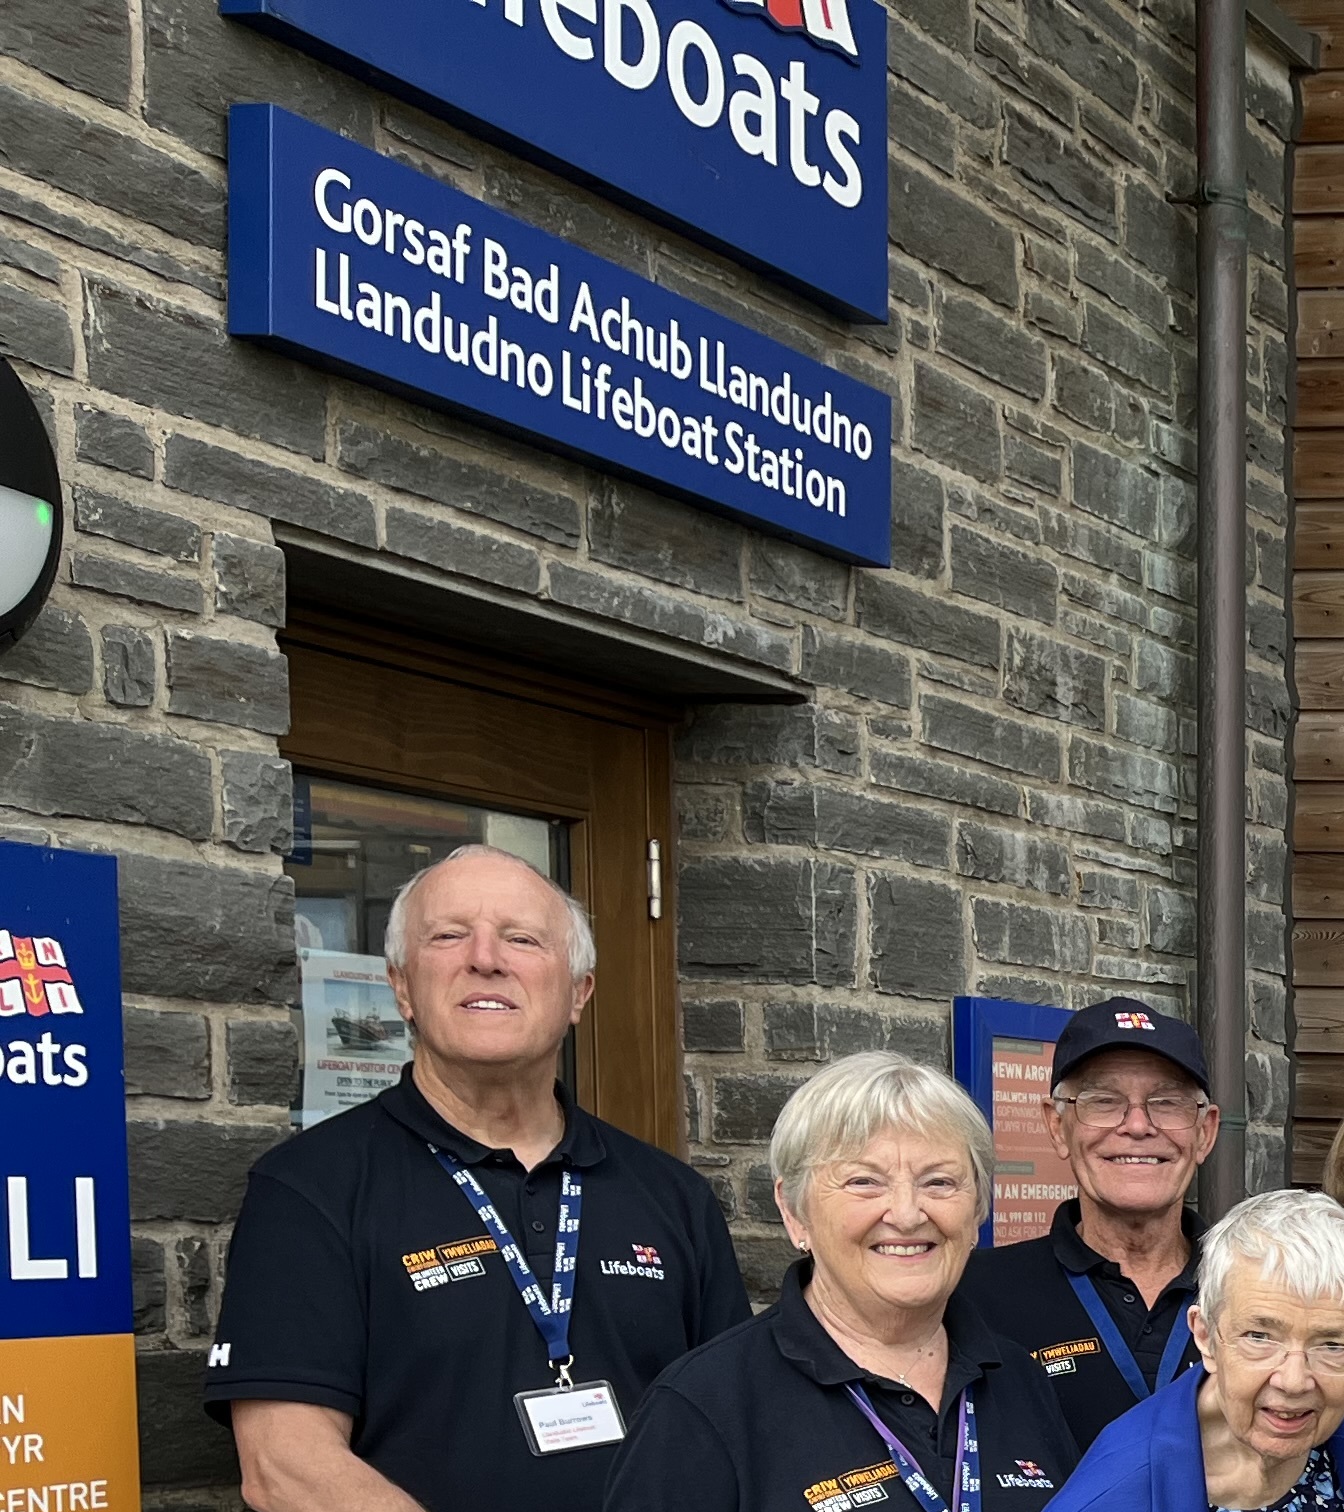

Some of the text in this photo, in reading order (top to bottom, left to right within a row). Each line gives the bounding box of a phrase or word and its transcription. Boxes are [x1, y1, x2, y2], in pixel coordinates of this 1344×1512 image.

[313, 167, 873, 462] Gorsaf Bad Achub Llandudno
[314, 248, 847, 517] Llandudno Lifeboat Station
[0, 1031, 89, 1087] ats
[1004, 1183, 1019, 1200] AN
[1021, 1184, 1079, 1201] EMERGENCY
[7, 1175, 97, 1280] LI
[401, 1248, 437, 1267] CRIW
[450, 1260, 480, 1277] VISITS
[600, 1259, 665, 1281] Lifeboats
[413, 1273, 450, 1292] CREW
[1042, 1341, 1095, 1360] YMWELIADAU
[1045, 1360, 1072, 1375] VISITS
[0, 1394, 26, 1425] N
[803, 1478, 838, 1500] CRIW
[995, 1474, 1055, 1489] Lifeboats
[852, 1486, 883, 1504] VISITS
